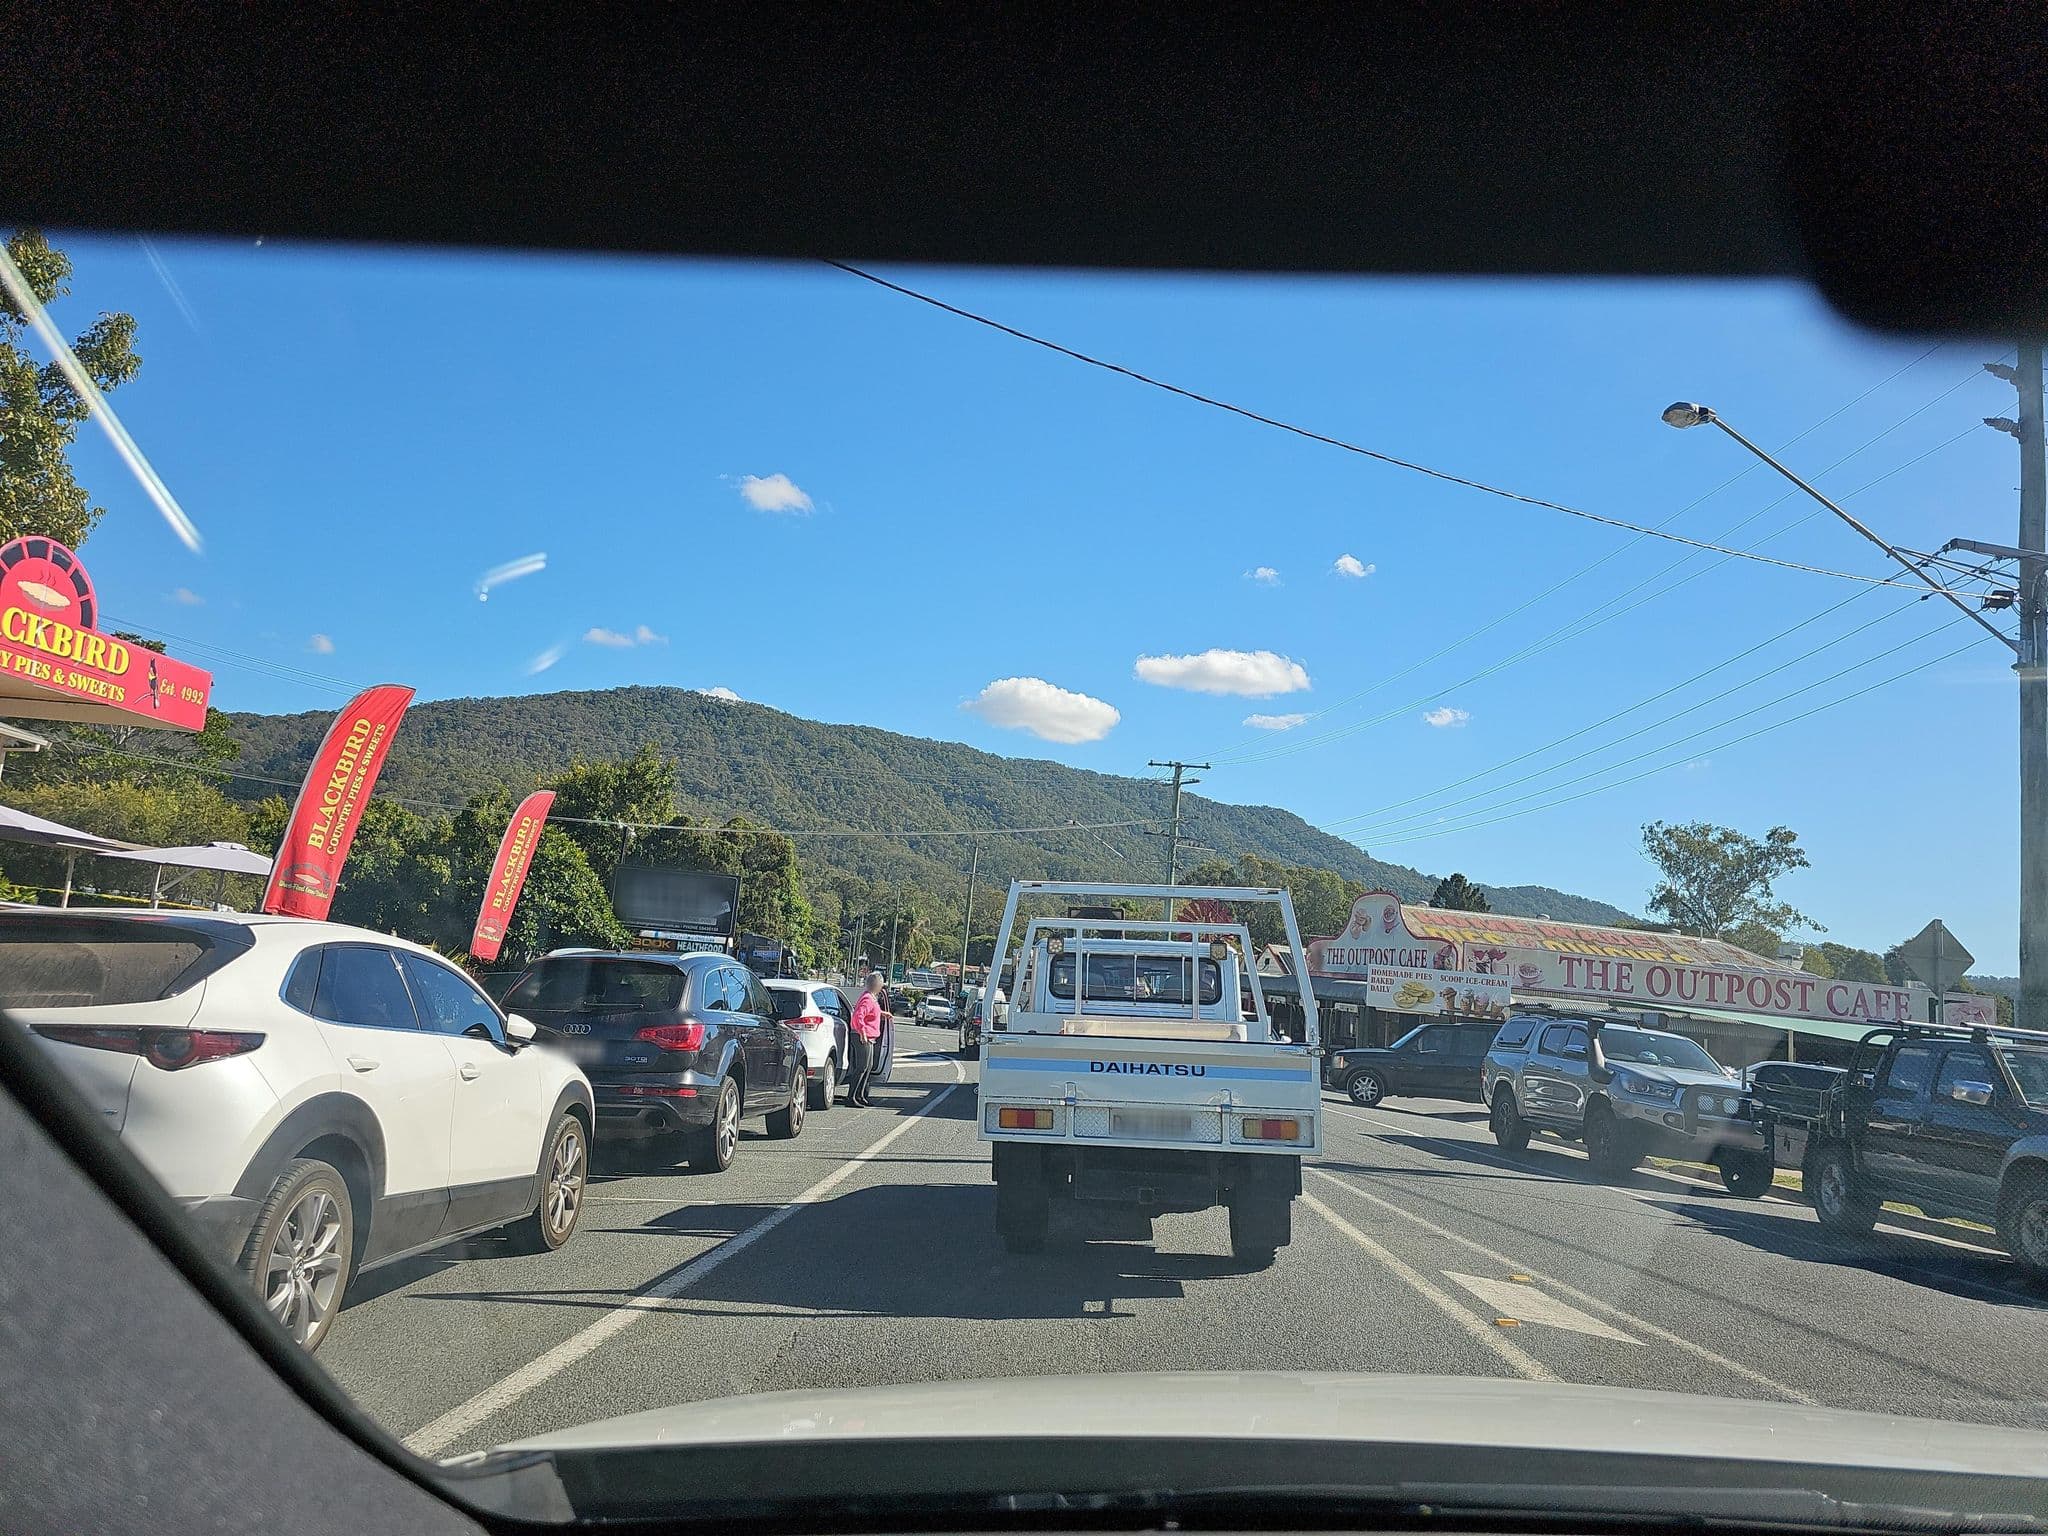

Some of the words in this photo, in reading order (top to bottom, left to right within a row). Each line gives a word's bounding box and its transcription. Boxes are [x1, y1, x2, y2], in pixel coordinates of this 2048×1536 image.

[0, 606, 130, 675] CKBIRD
[0, 649, 13, 669] Y
[14, 653, 52, 681] PIES
[53, 668, 65, 684] &
[67, 671, 126, 703] SWEETS
[160, 678, 177, 698] Est.
[360, 722, 386, 767] SWEETS
[357, 766, 369, 778] &
[308, 718, 371, 850] BLACKBIRD
[347, 774, 363, 801] PIES
[326, 799, 353, 856] COUNTRY
[492, 816, 532, 910] BLACKBIRD
[676, 941, 723, 954] HEALTHFOOD
[1327, 948, 1345, 965] THE
[1347, 948, 1397, 968] OUTPOST
[1398, 949, 1428, 968] CAFE
[1370, 977, 1394, 986] BAKED
[1371, 968, 1414, 980] HOMEMADE
[1415, 973, 1432, 981] PIES
[1439, 974, 1464, 984] SCOOP
[1465, 977, 1508, 988] ICE-CREAM
[1370, 984, 1391, 993] DAILY
[1559, 955, 1635, 995] THE
[1646, 965, 1816, 1014] OUTPOST
[1826, 985, 1911, 1022] CAFE
[1090, 1061, 1207, 1077] DAIHATSU
